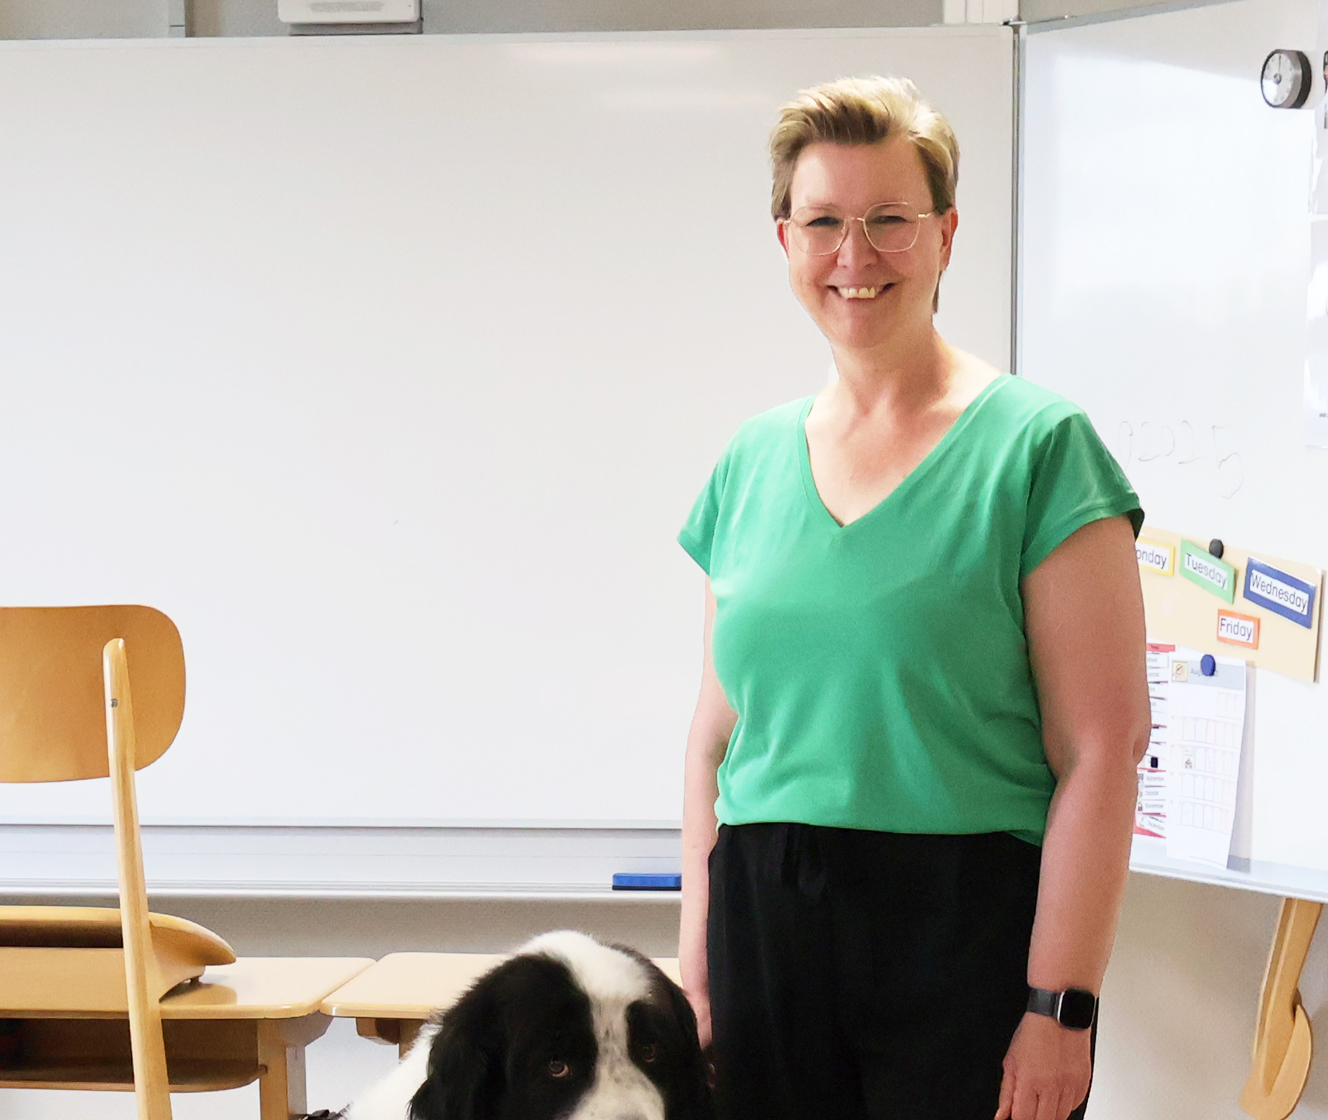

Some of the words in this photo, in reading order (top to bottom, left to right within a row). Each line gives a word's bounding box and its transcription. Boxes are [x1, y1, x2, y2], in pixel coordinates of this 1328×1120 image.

[1137, 549, 1167, 569] onday
[1186, 553, 1227, 589] Tuesday
[1252, 574, 1308, 614] Wednesday
[1220, 617, 1253, 641] Friday
